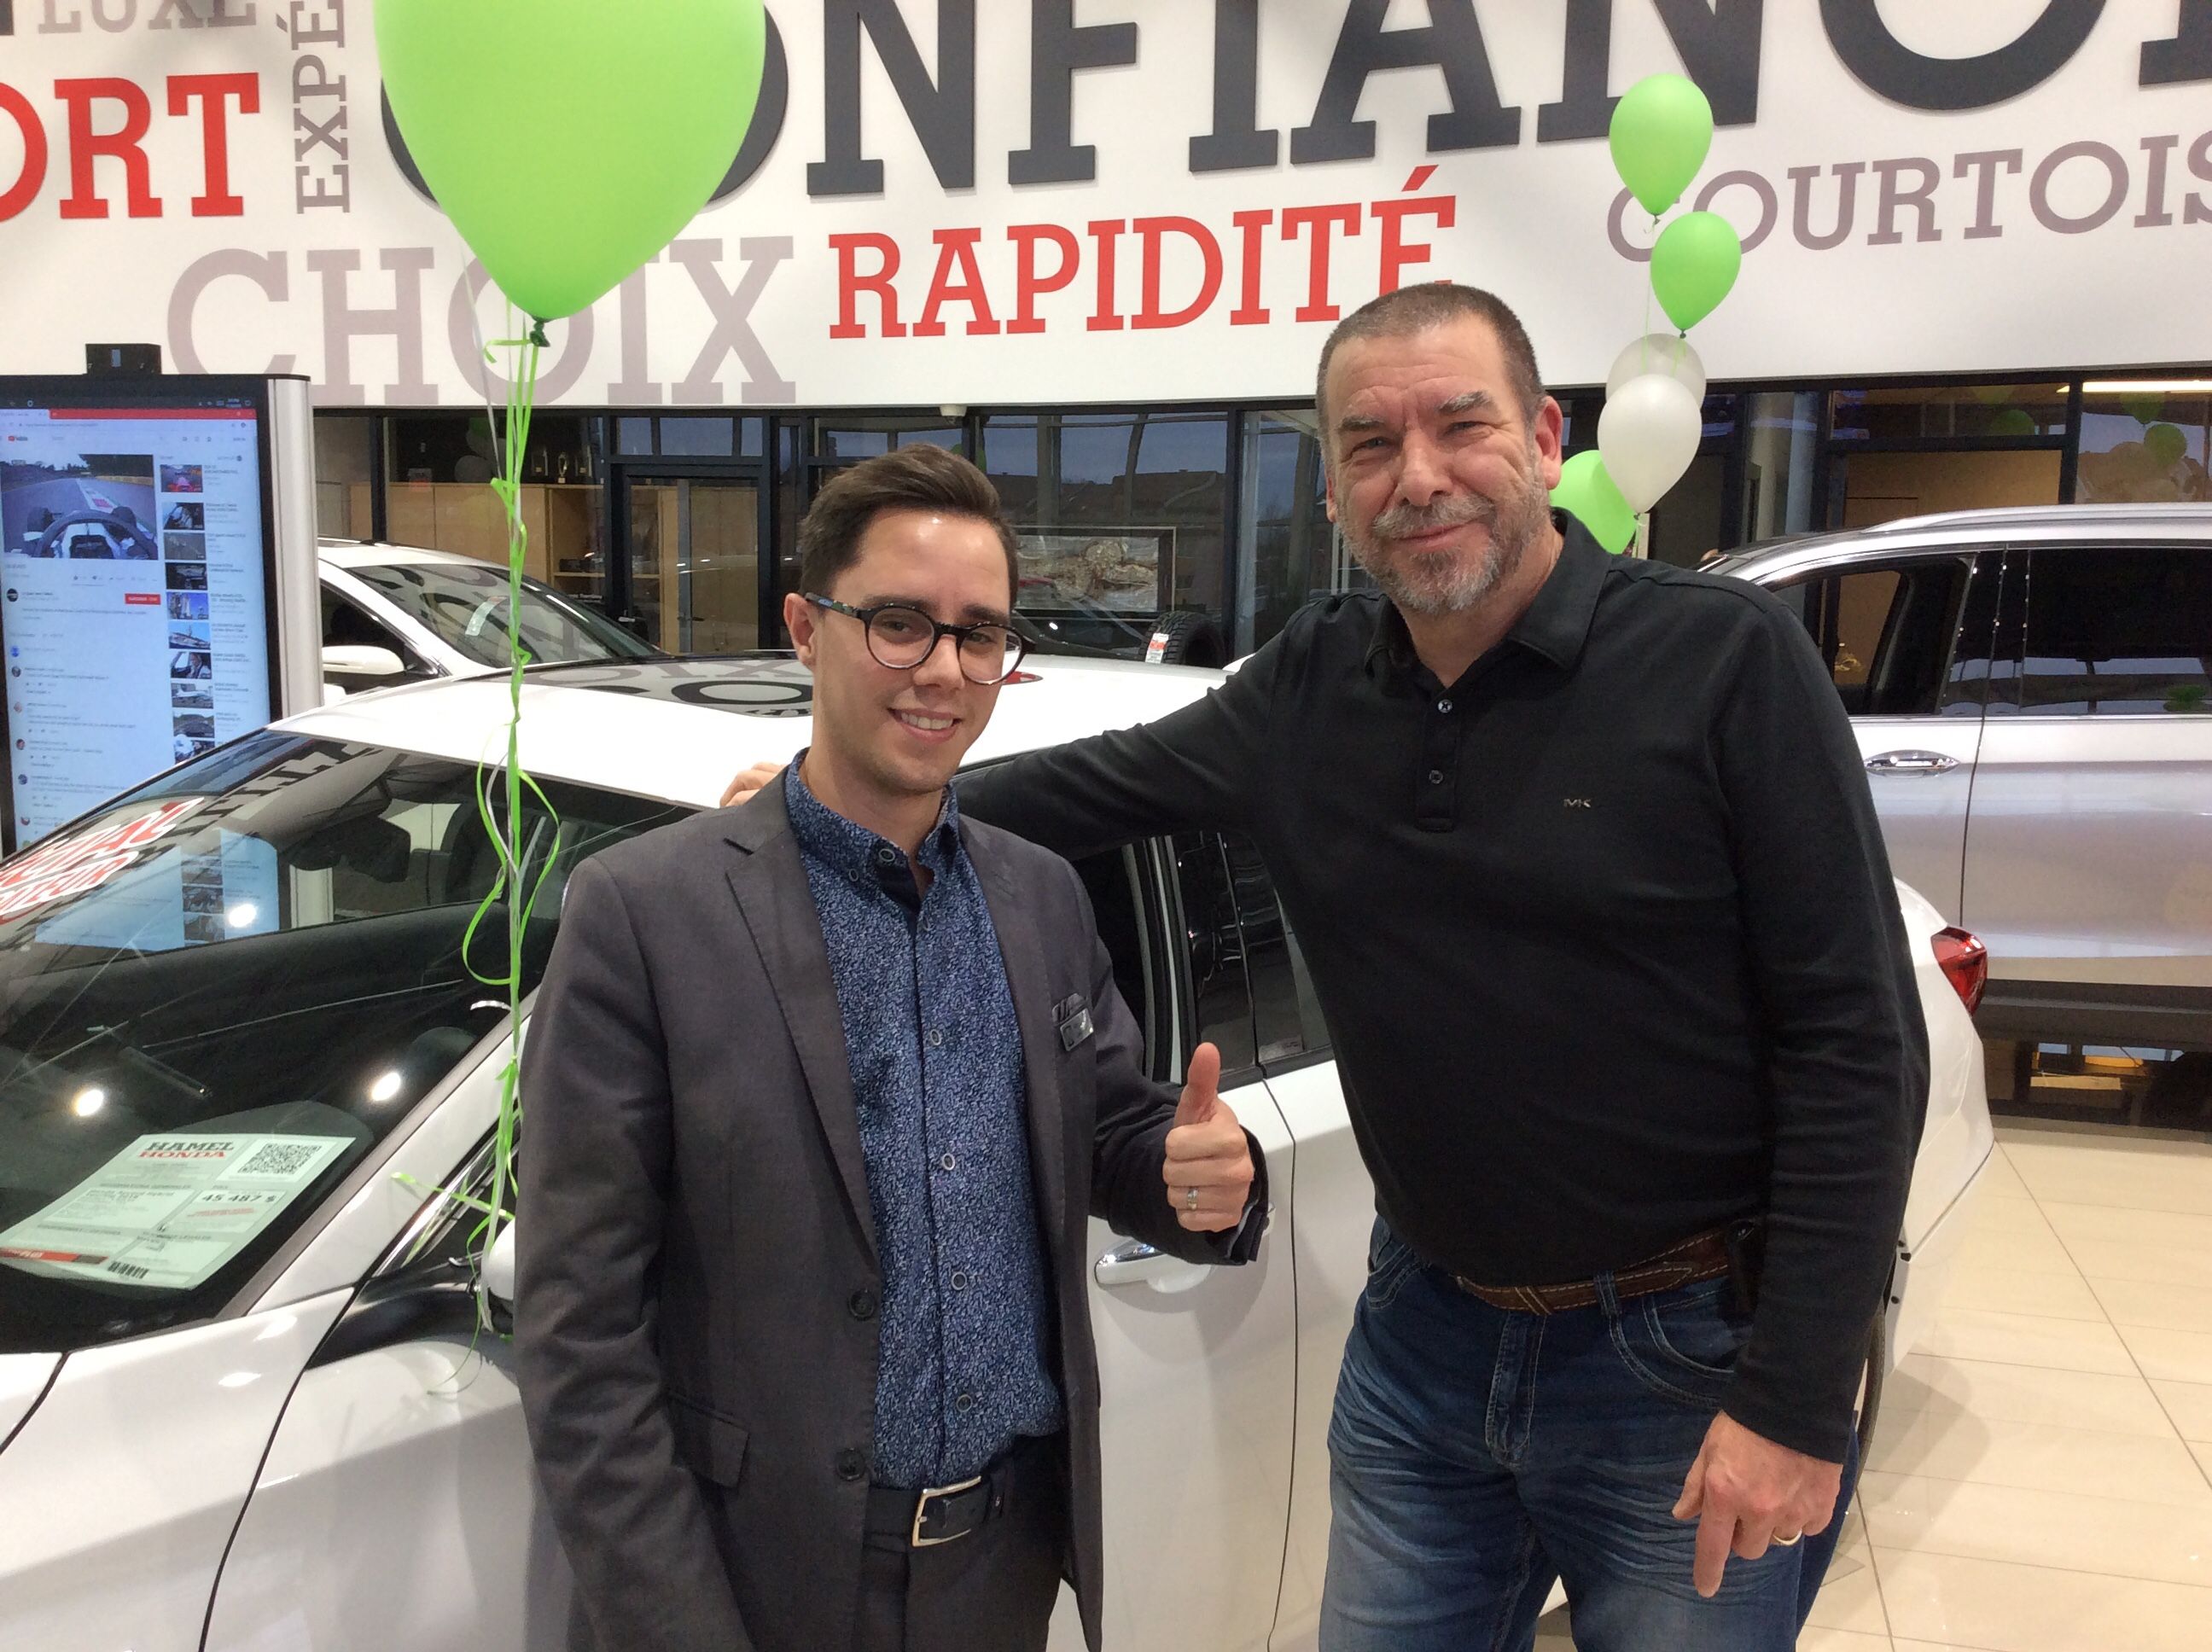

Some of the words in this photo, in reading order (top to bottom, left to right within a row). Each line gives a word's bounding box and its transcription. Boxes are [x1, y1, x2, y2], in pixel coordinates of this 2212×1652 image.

[381, 0, 2212, 213] NFIAN
[167, 236, 796, 405] CHOIX
[830, 164, 1456, 340] RAPIDITÉ
[147, 1142, 235, 1150] HAMEL
